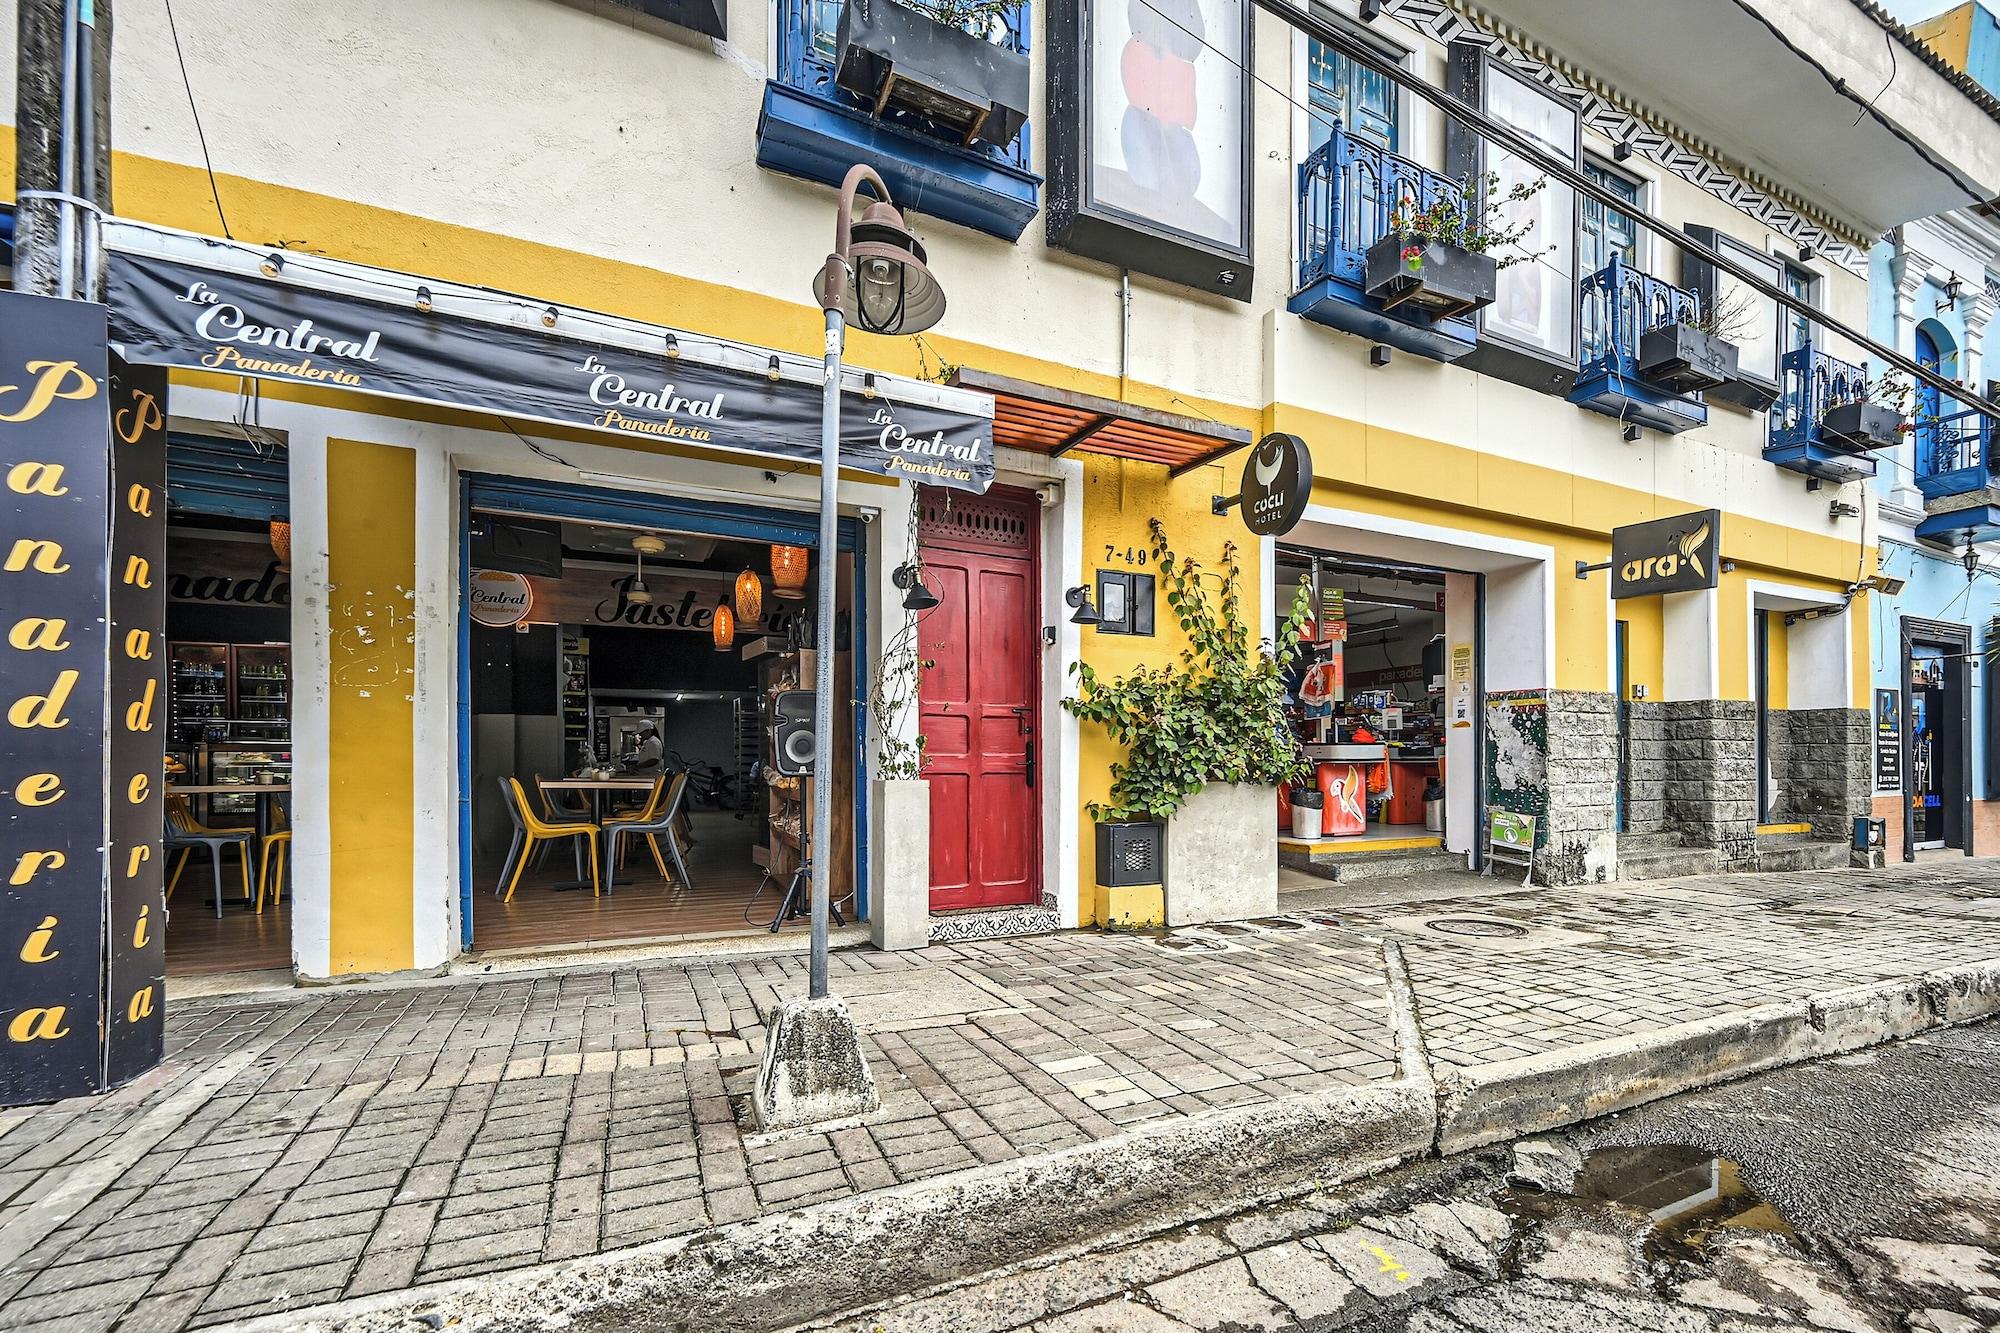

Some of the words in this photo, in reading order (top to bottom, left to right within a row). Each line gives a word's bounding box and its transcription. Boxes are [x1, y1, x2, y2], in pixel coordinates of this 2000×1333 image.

[175, 281, 219, 305] La
[195, 303, 381, 362] Central
[574, 355, 608, 375] La
[589, 373, 724, 420] Central
[868, 408, 893, 425] La
[879, 423, 982, 462] Central
[1255, 514, 1283, 526] HOTEL
[1105, 544, 1147, 566] 7-49
[1621, 553, 1679, 582] ara
[471, 589, 526, 605] Central
